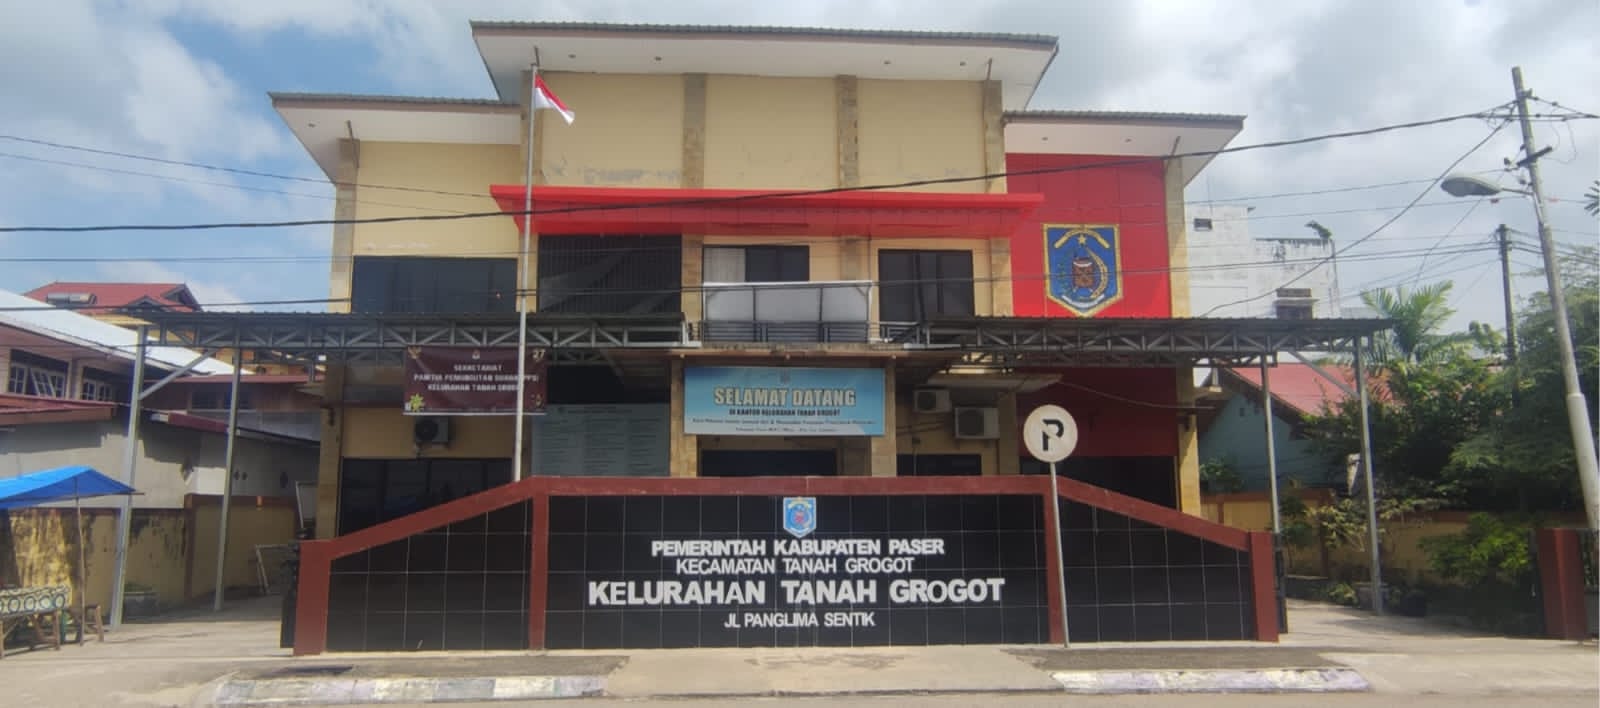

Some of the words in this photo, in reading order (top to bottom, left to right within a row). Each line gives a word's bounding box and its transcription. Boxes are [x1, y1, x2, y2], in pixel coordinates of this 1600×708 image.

[453, 364, 502, 372] SEKRETARIAT
[428, 383, 470, 392] KELURAHAN
[472, 383, 496, 392] TANAH
[714, 387, 788, 406] SELAMAT
[792, 388, 856, 407] DATANG
[737, 408, 760, 416] KANTOR
[761, 408, 795, 416] KELURAHAN
[797, 409, 815, 417] TANAH
[817, 409, 840, 417] GROGOT
[1042, 418, 1065, 451] P
[651, 540, 765, 556] PEMERINTAH
[774, 539, 881, 556] KABUPATEN
[888, 538, 945, 555] PASER
[676, 558, 775, 574] KECAMATAN
[782, 558, 837, 574] TANAH
[845, 557, 915, 573] GROGOT
[588, 581, 765, 606] KELURAHAN
[781, 580, 877, 604] TANAH
[889, 578, 1006, 603] GROGOT
[724, 613, 741, 628] JL
[744, 612, 819, 628] PANGLIMA
[823, 611, 875, 628] SENTIK
